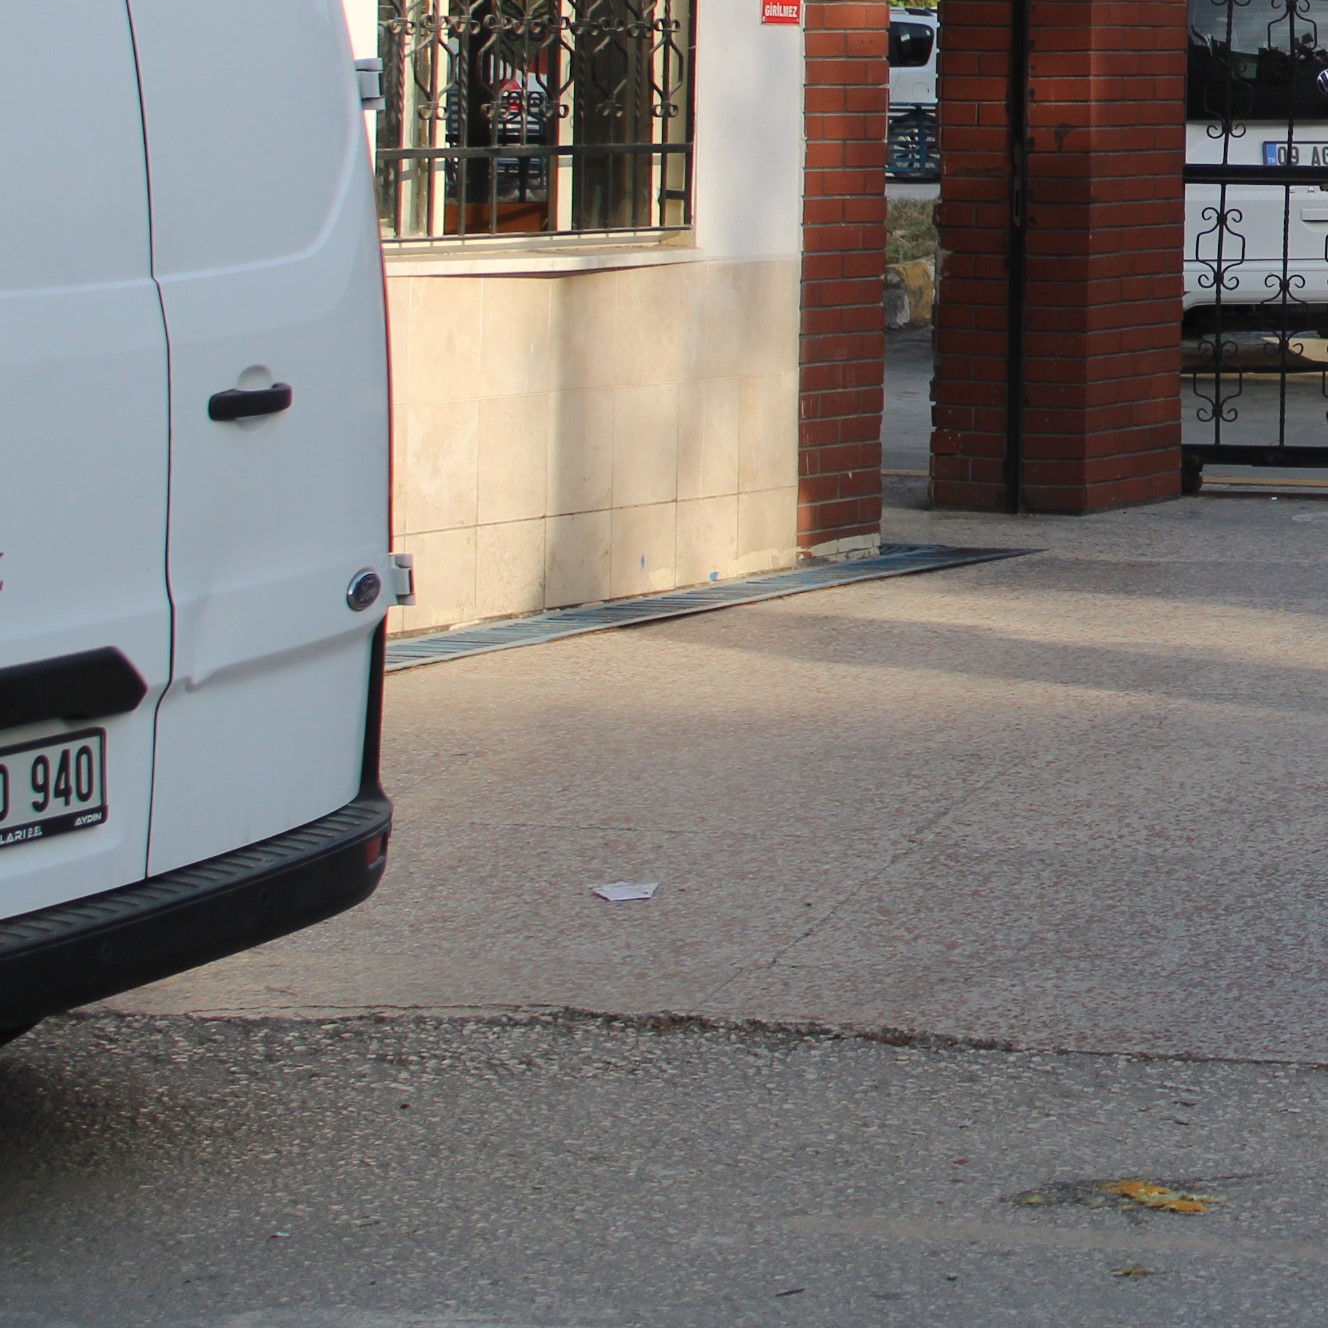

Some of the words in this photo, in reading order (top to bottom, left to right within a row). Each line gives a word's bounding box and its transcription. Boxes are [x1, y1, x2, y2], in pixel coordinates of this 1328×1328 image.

[764, 2, 798, 18] GİRİLMEZ
[31, 744, 94, 812] 940
[74, 812, 102, 826] AYDIN
